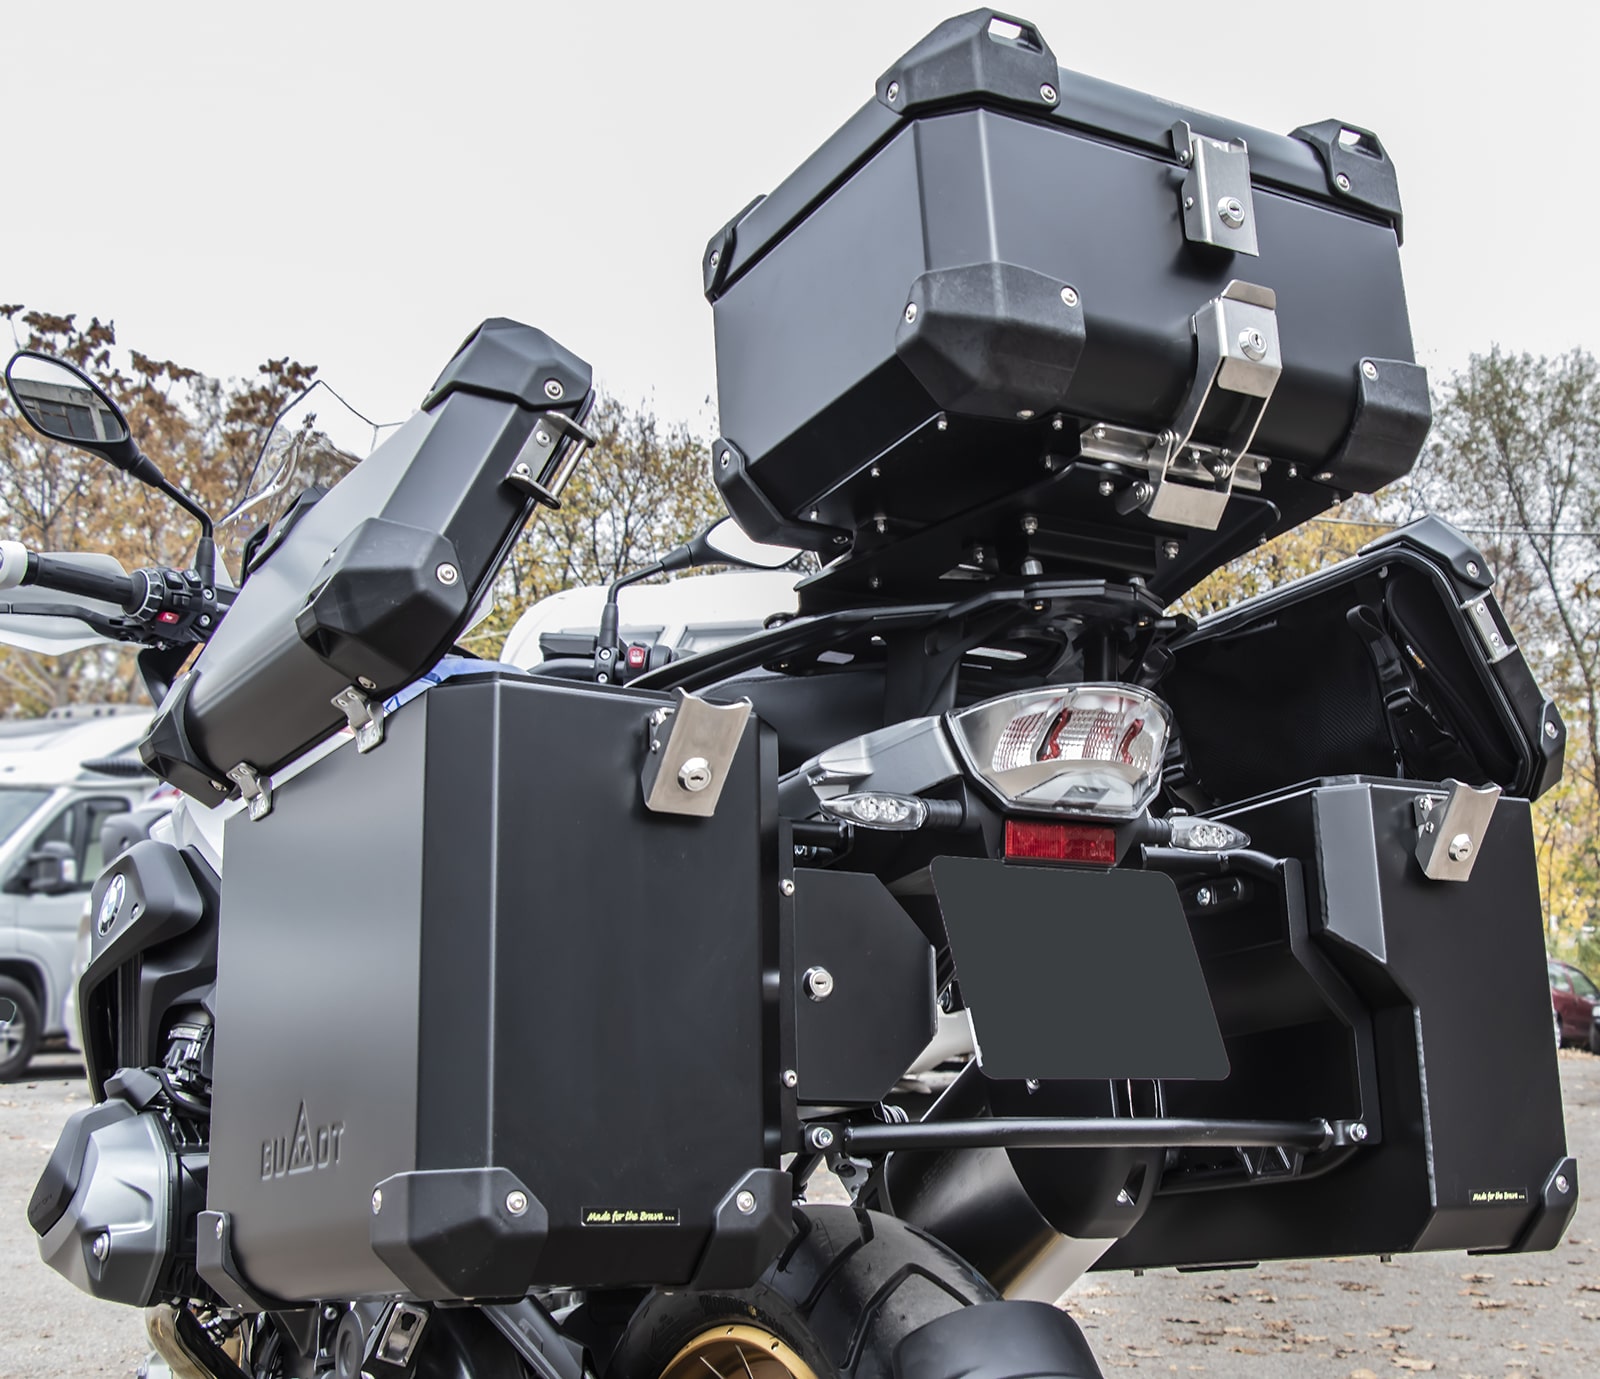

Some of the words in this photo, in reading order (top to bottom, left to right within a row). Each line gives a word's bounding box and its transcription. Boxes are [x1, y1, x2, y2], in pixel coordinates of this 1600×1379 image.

[587, 1211, 611, 1222] Made
[611, 1210, 625, 1224] for
[625, 1210, 638, 1221] the
